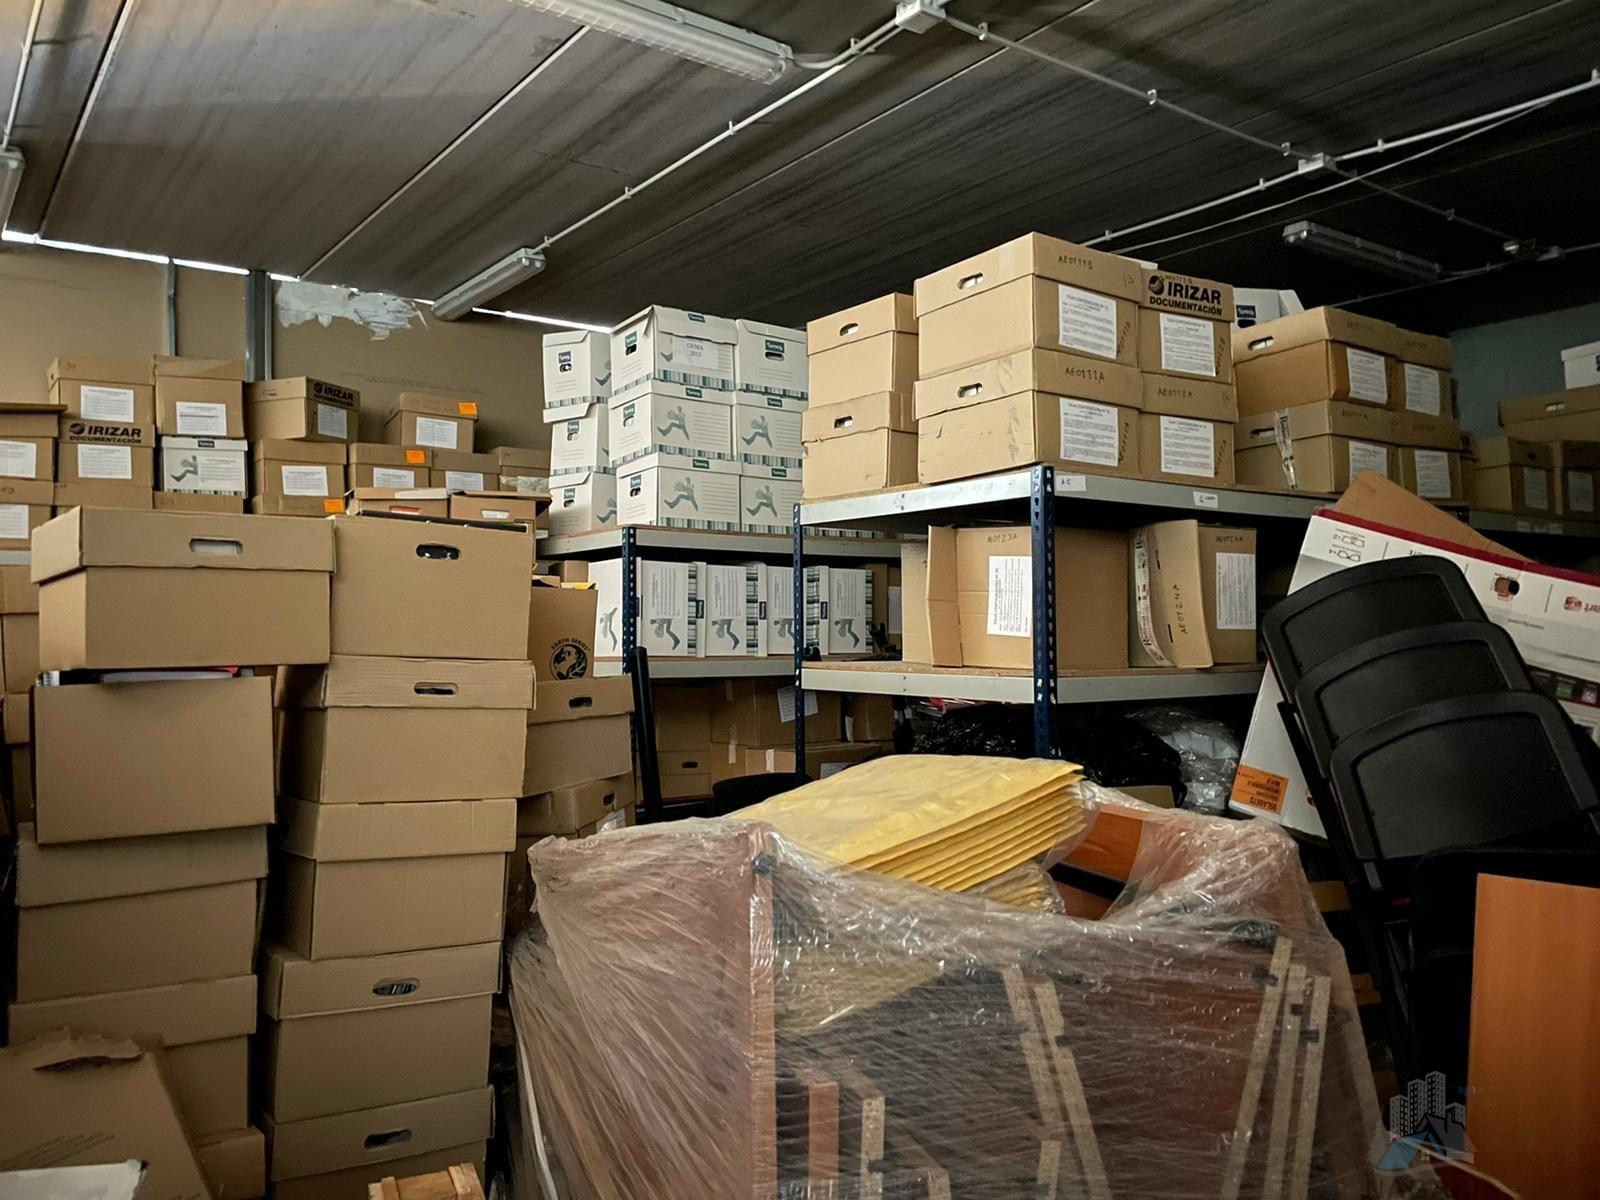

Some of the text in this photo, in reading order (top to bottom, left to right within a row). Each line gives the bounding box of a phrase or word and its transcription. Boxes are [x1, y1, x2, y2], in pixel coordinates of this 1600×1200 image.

[1167, 281, 1222, 304] IRIZAR
[1149, 296, 1222, 316] DOCUMENTACIÓN
[324, 385, 354, 402] IRIZAR
[69, 435, 142, 444] DOCUMENTACIÓN
[87, 425, 142, 438] IRIZAR
